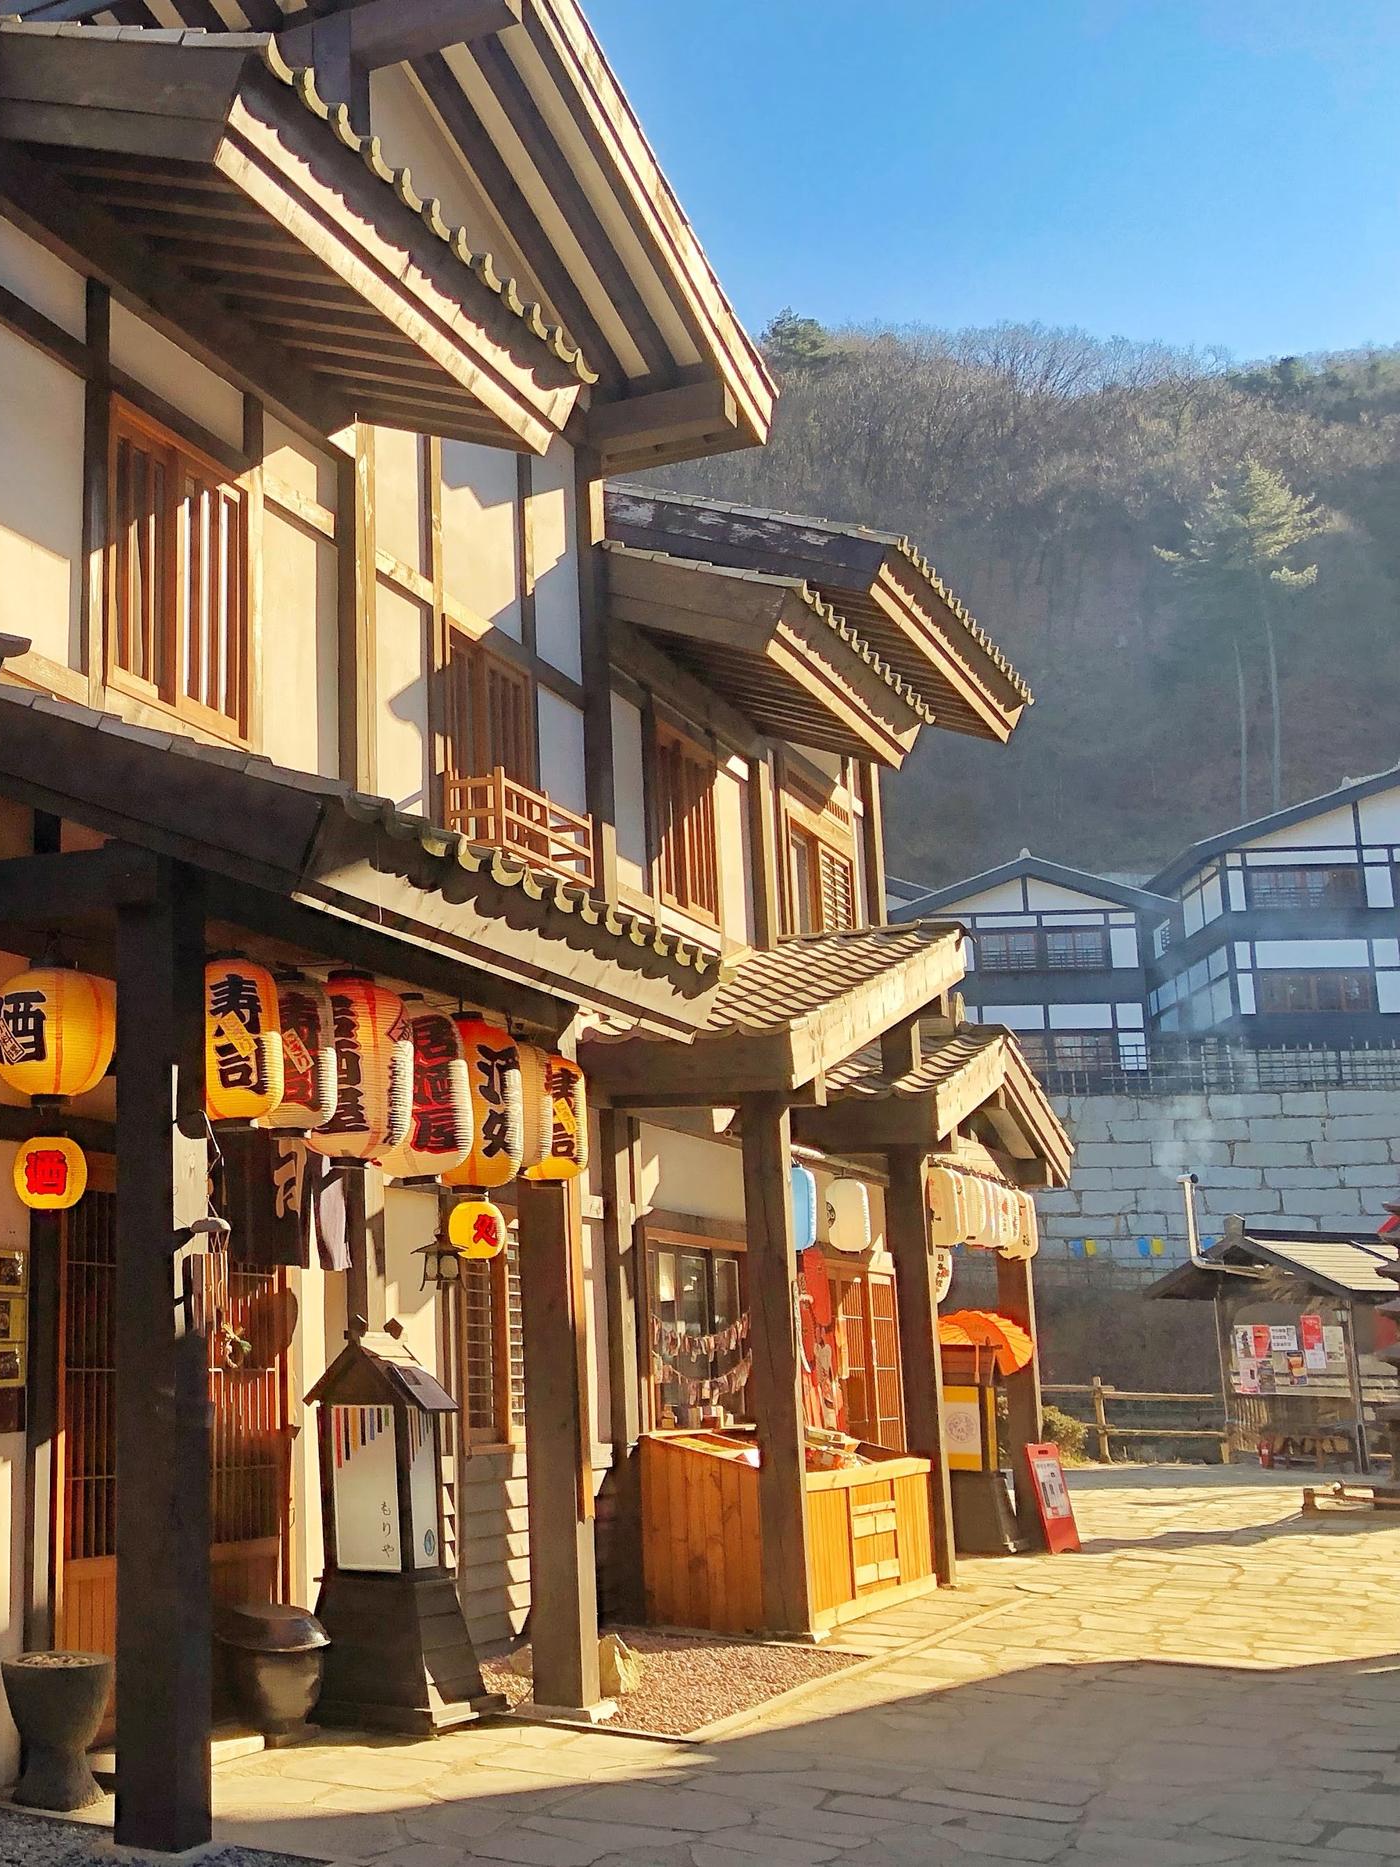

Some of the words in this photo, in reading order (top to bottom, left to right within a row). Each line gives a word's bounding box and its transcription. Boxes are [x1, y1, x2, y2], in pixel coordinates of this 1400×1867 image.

[210, 974, 268, 1095] 寿司
[411, 1014, 464, 1154] 居酒屋
[25, 1149, 67, 1196] 酒
[381, 1501, 395, 1558] もりや
